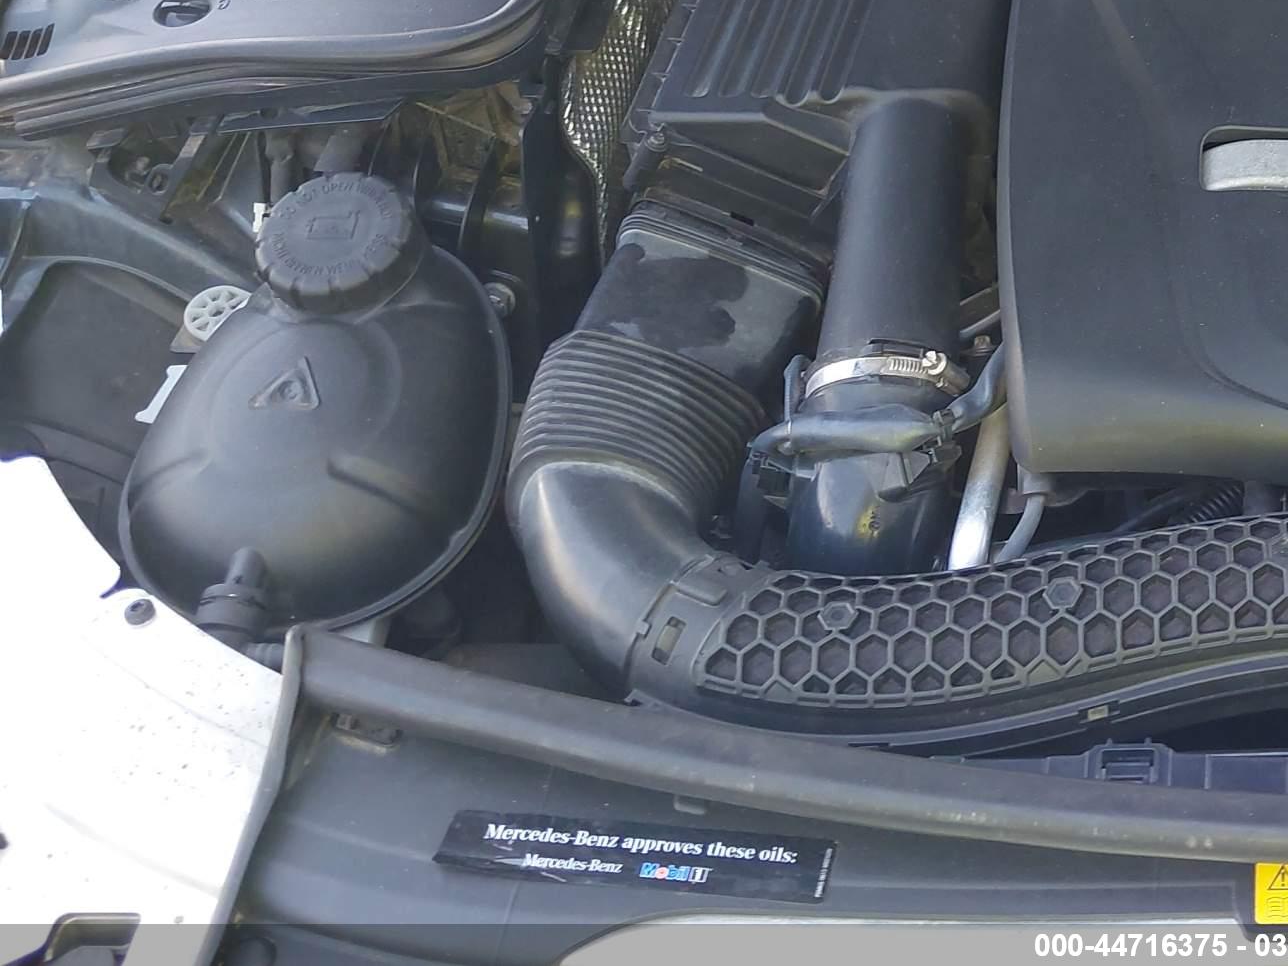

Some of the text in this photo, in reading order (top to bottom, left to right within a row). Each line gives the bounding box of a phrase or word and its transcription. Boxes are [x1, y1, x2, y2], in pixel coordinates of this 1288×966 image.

[321, 182, 354, 195] OPEN
[483, 823, 799, 864] Mercedes-Benz approves these oils:
[521, 853, 624, 874] Mercedes-Benz
[639, 862, 692, 882] Mobil
